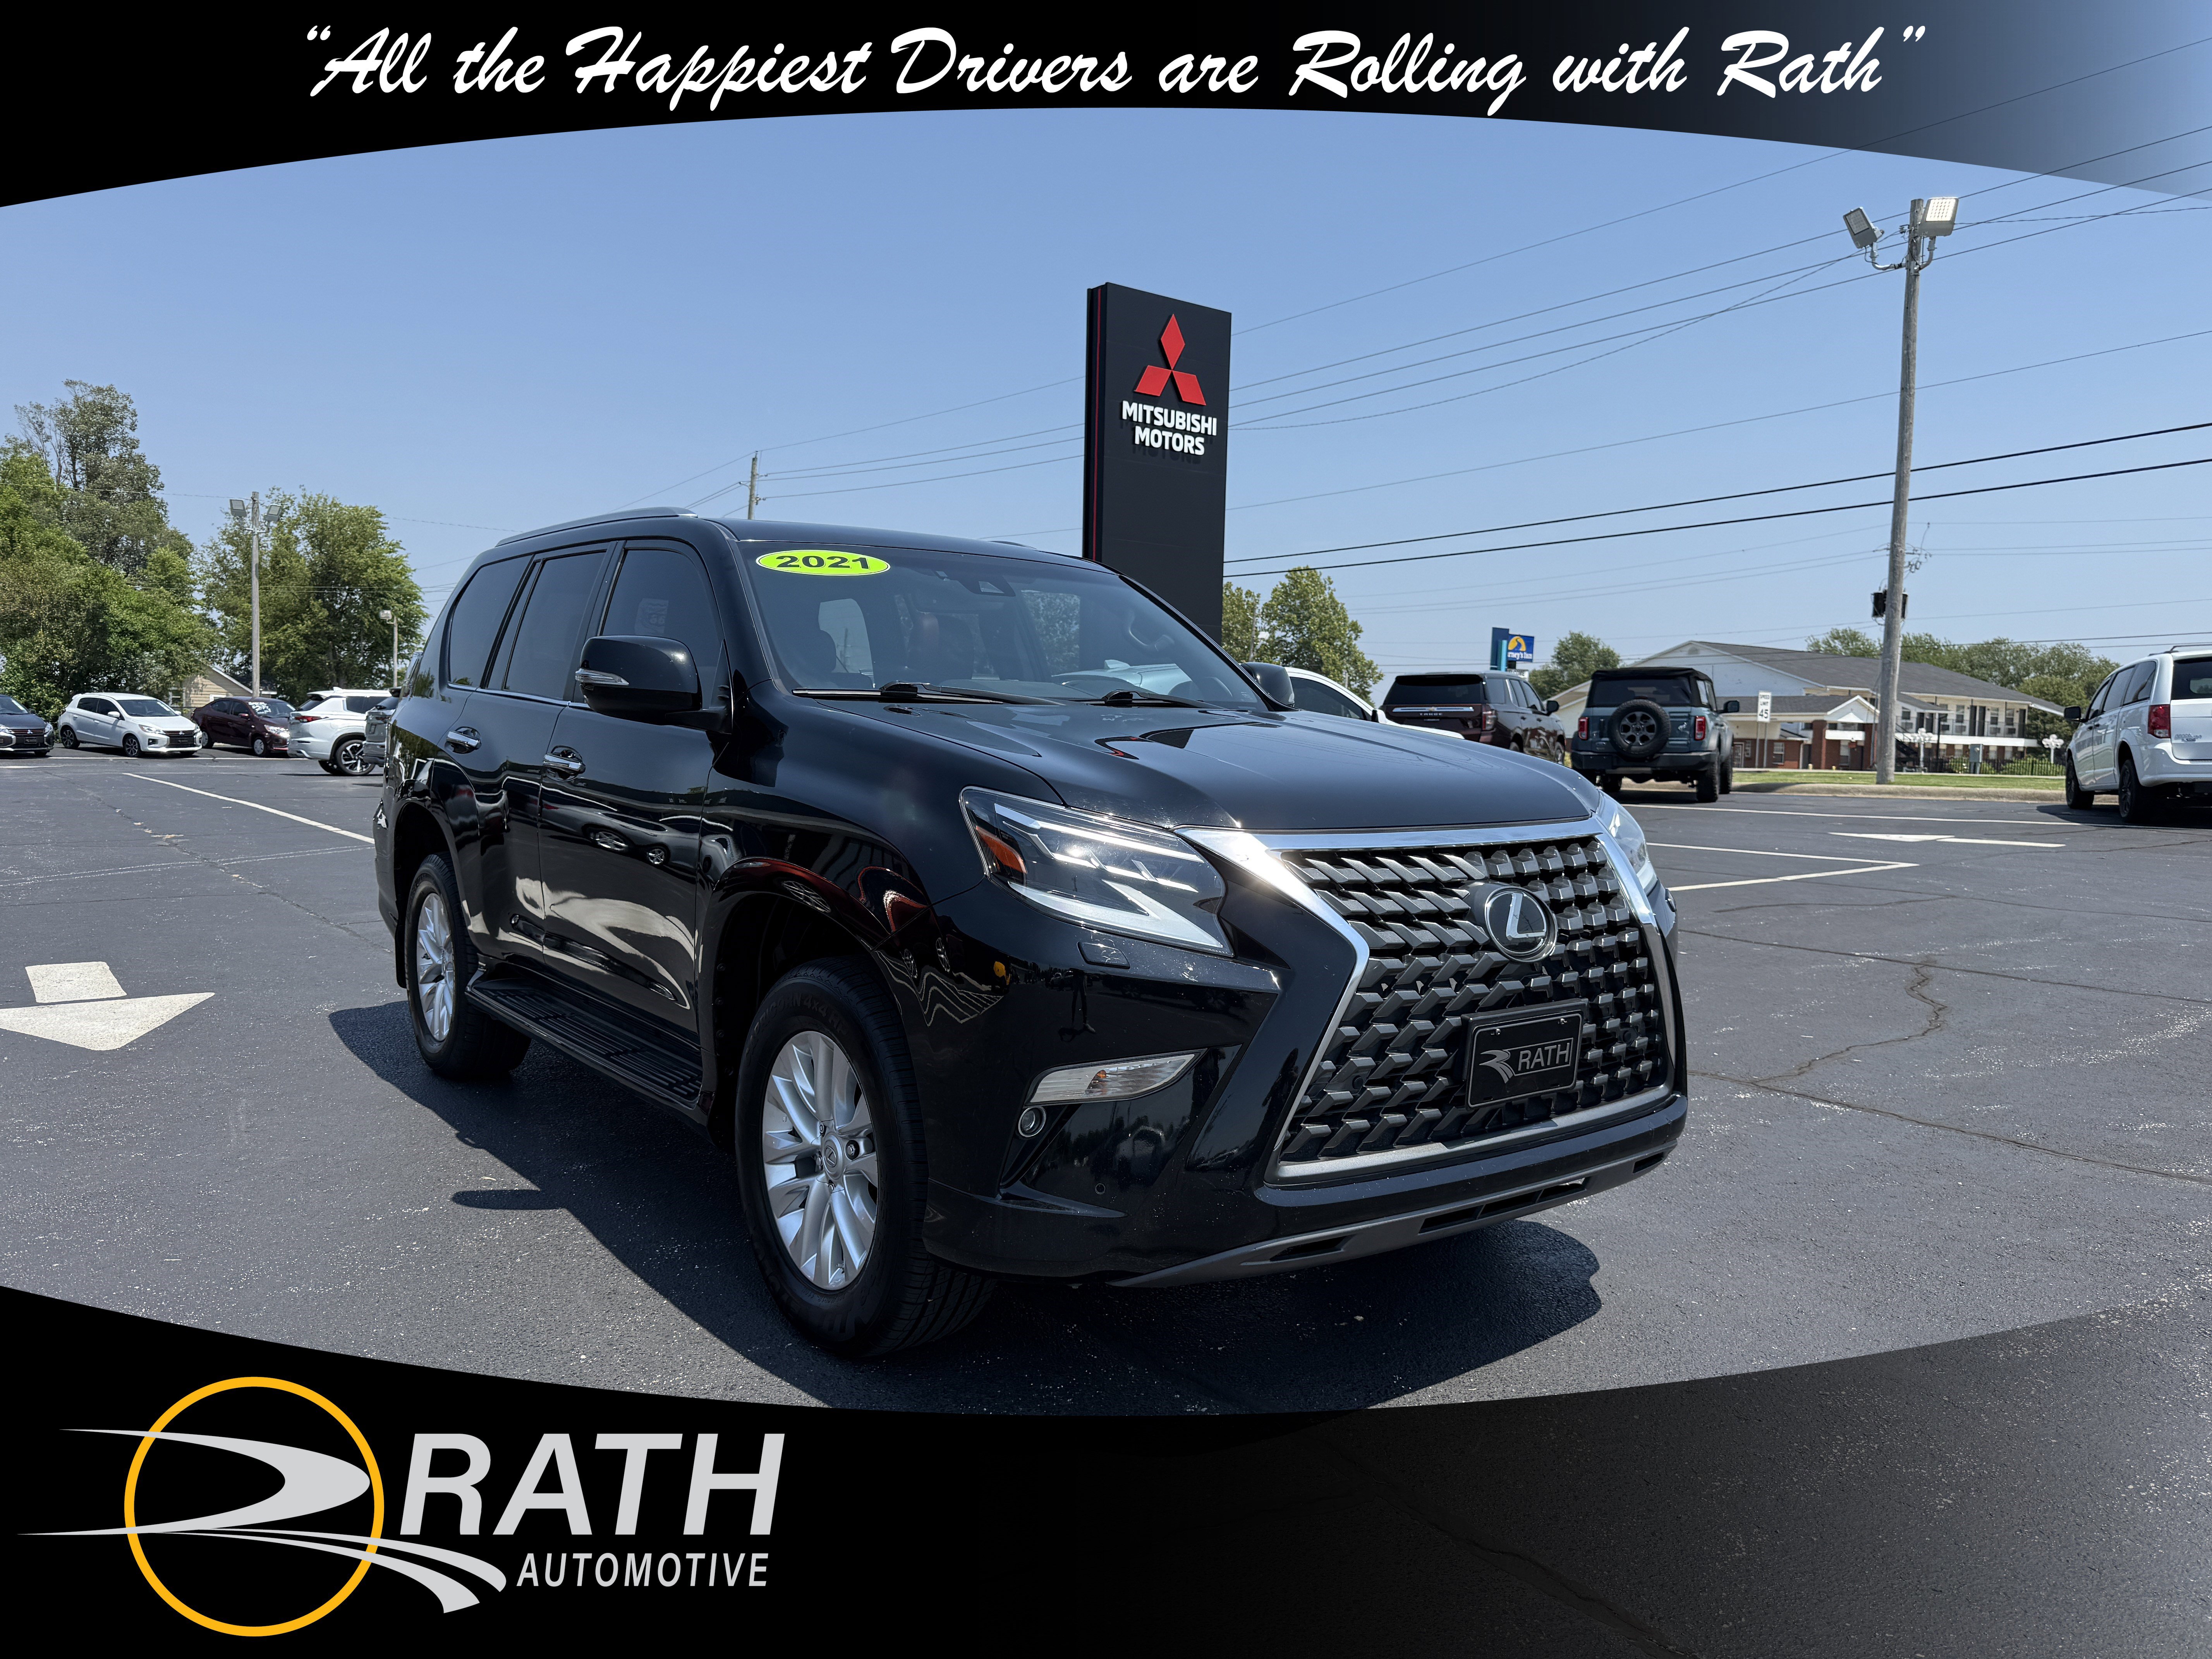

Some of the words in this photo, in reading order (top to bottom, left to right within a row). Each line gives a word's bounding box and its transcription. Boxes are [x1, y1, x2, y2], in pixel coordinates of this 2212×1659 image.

[1122, 400, 1217, 436] MITSUBISHI
[1135, 426, 1205, 455] MOTORS
[776, 556, 869, 569] 2021
[1759, 709, 1768, 718] 45
[1518, 1042, 1570, 1071] RATH
